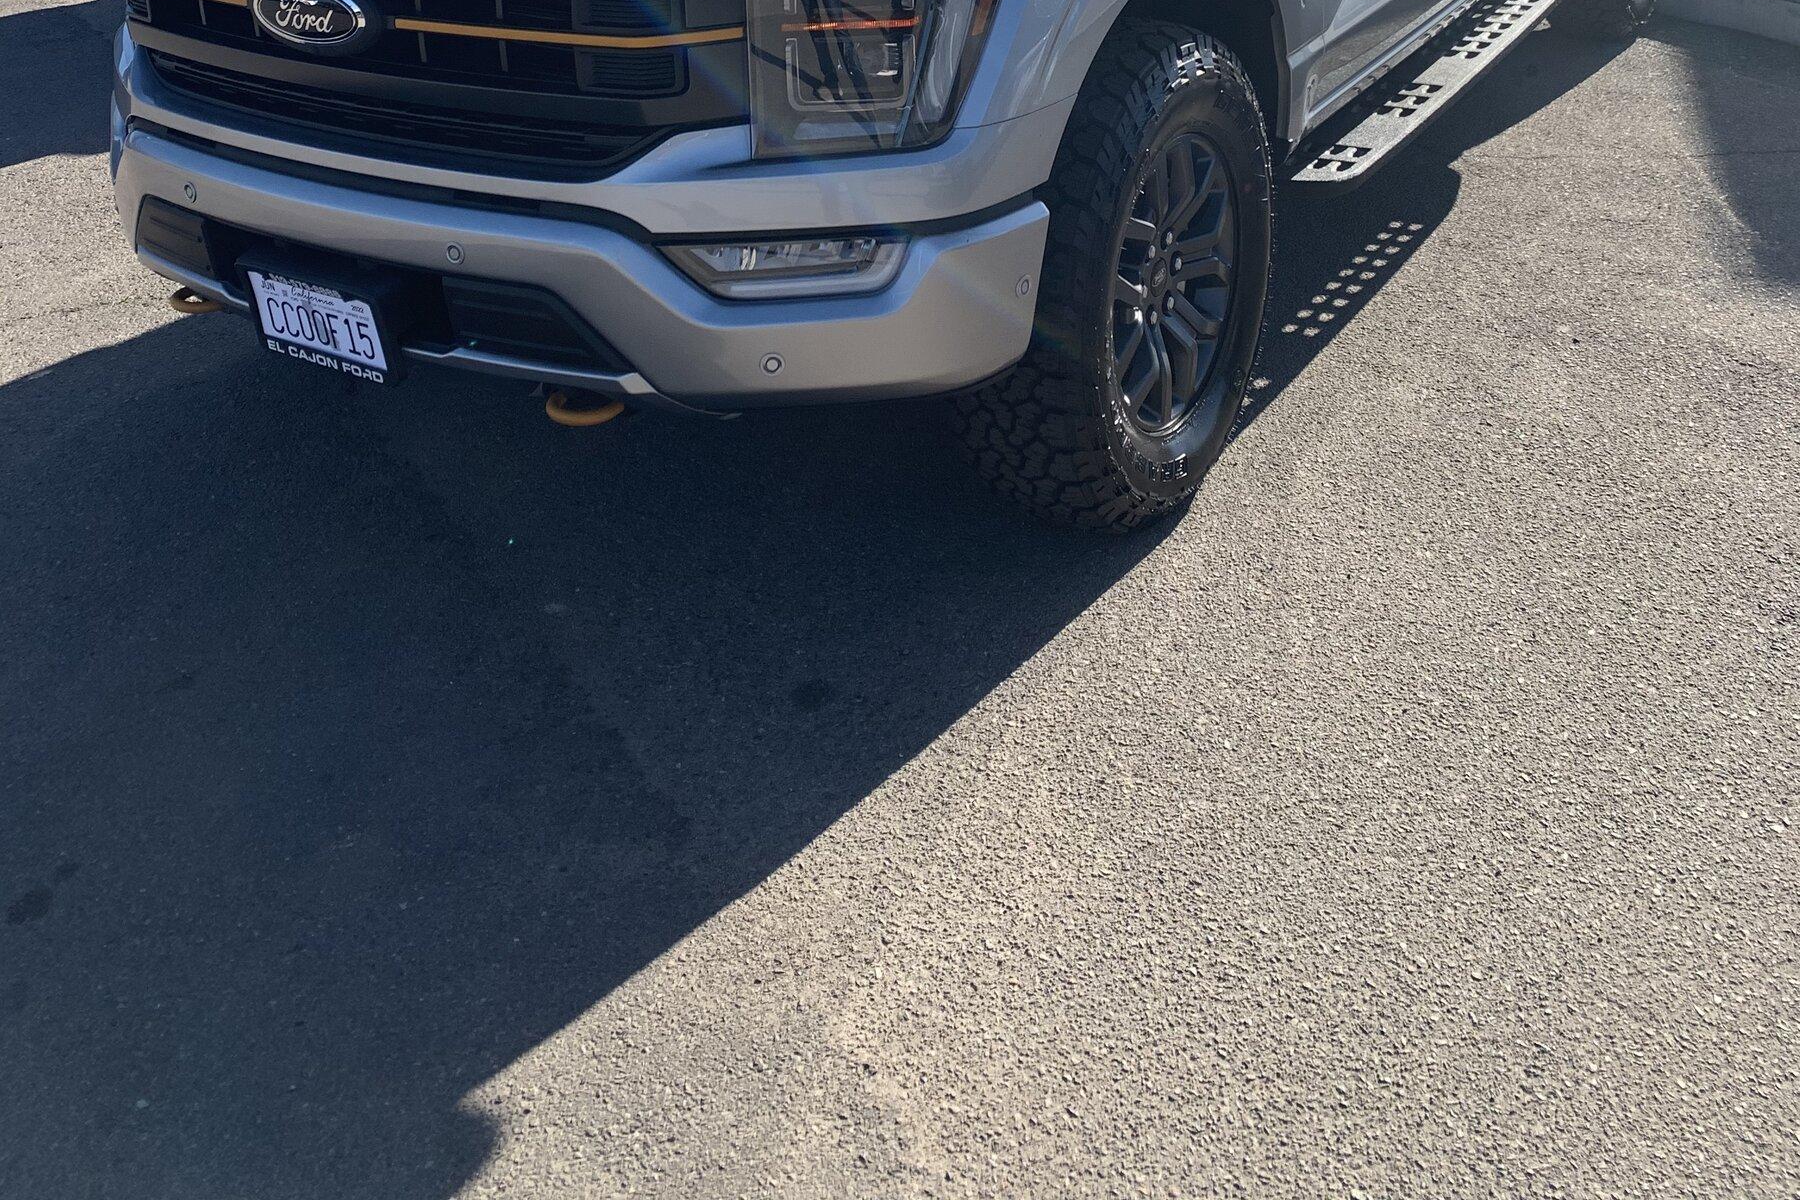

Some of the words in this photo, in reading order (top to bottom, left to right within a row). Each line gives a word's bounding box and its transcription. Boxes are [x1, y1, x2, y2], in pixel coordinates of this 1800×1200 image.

[291, 285, 335, 307] California
[266, 339, 285, 354] EL
[288, 345, 339, 370] CAJON
[342, 361, 384, 384] FORD
